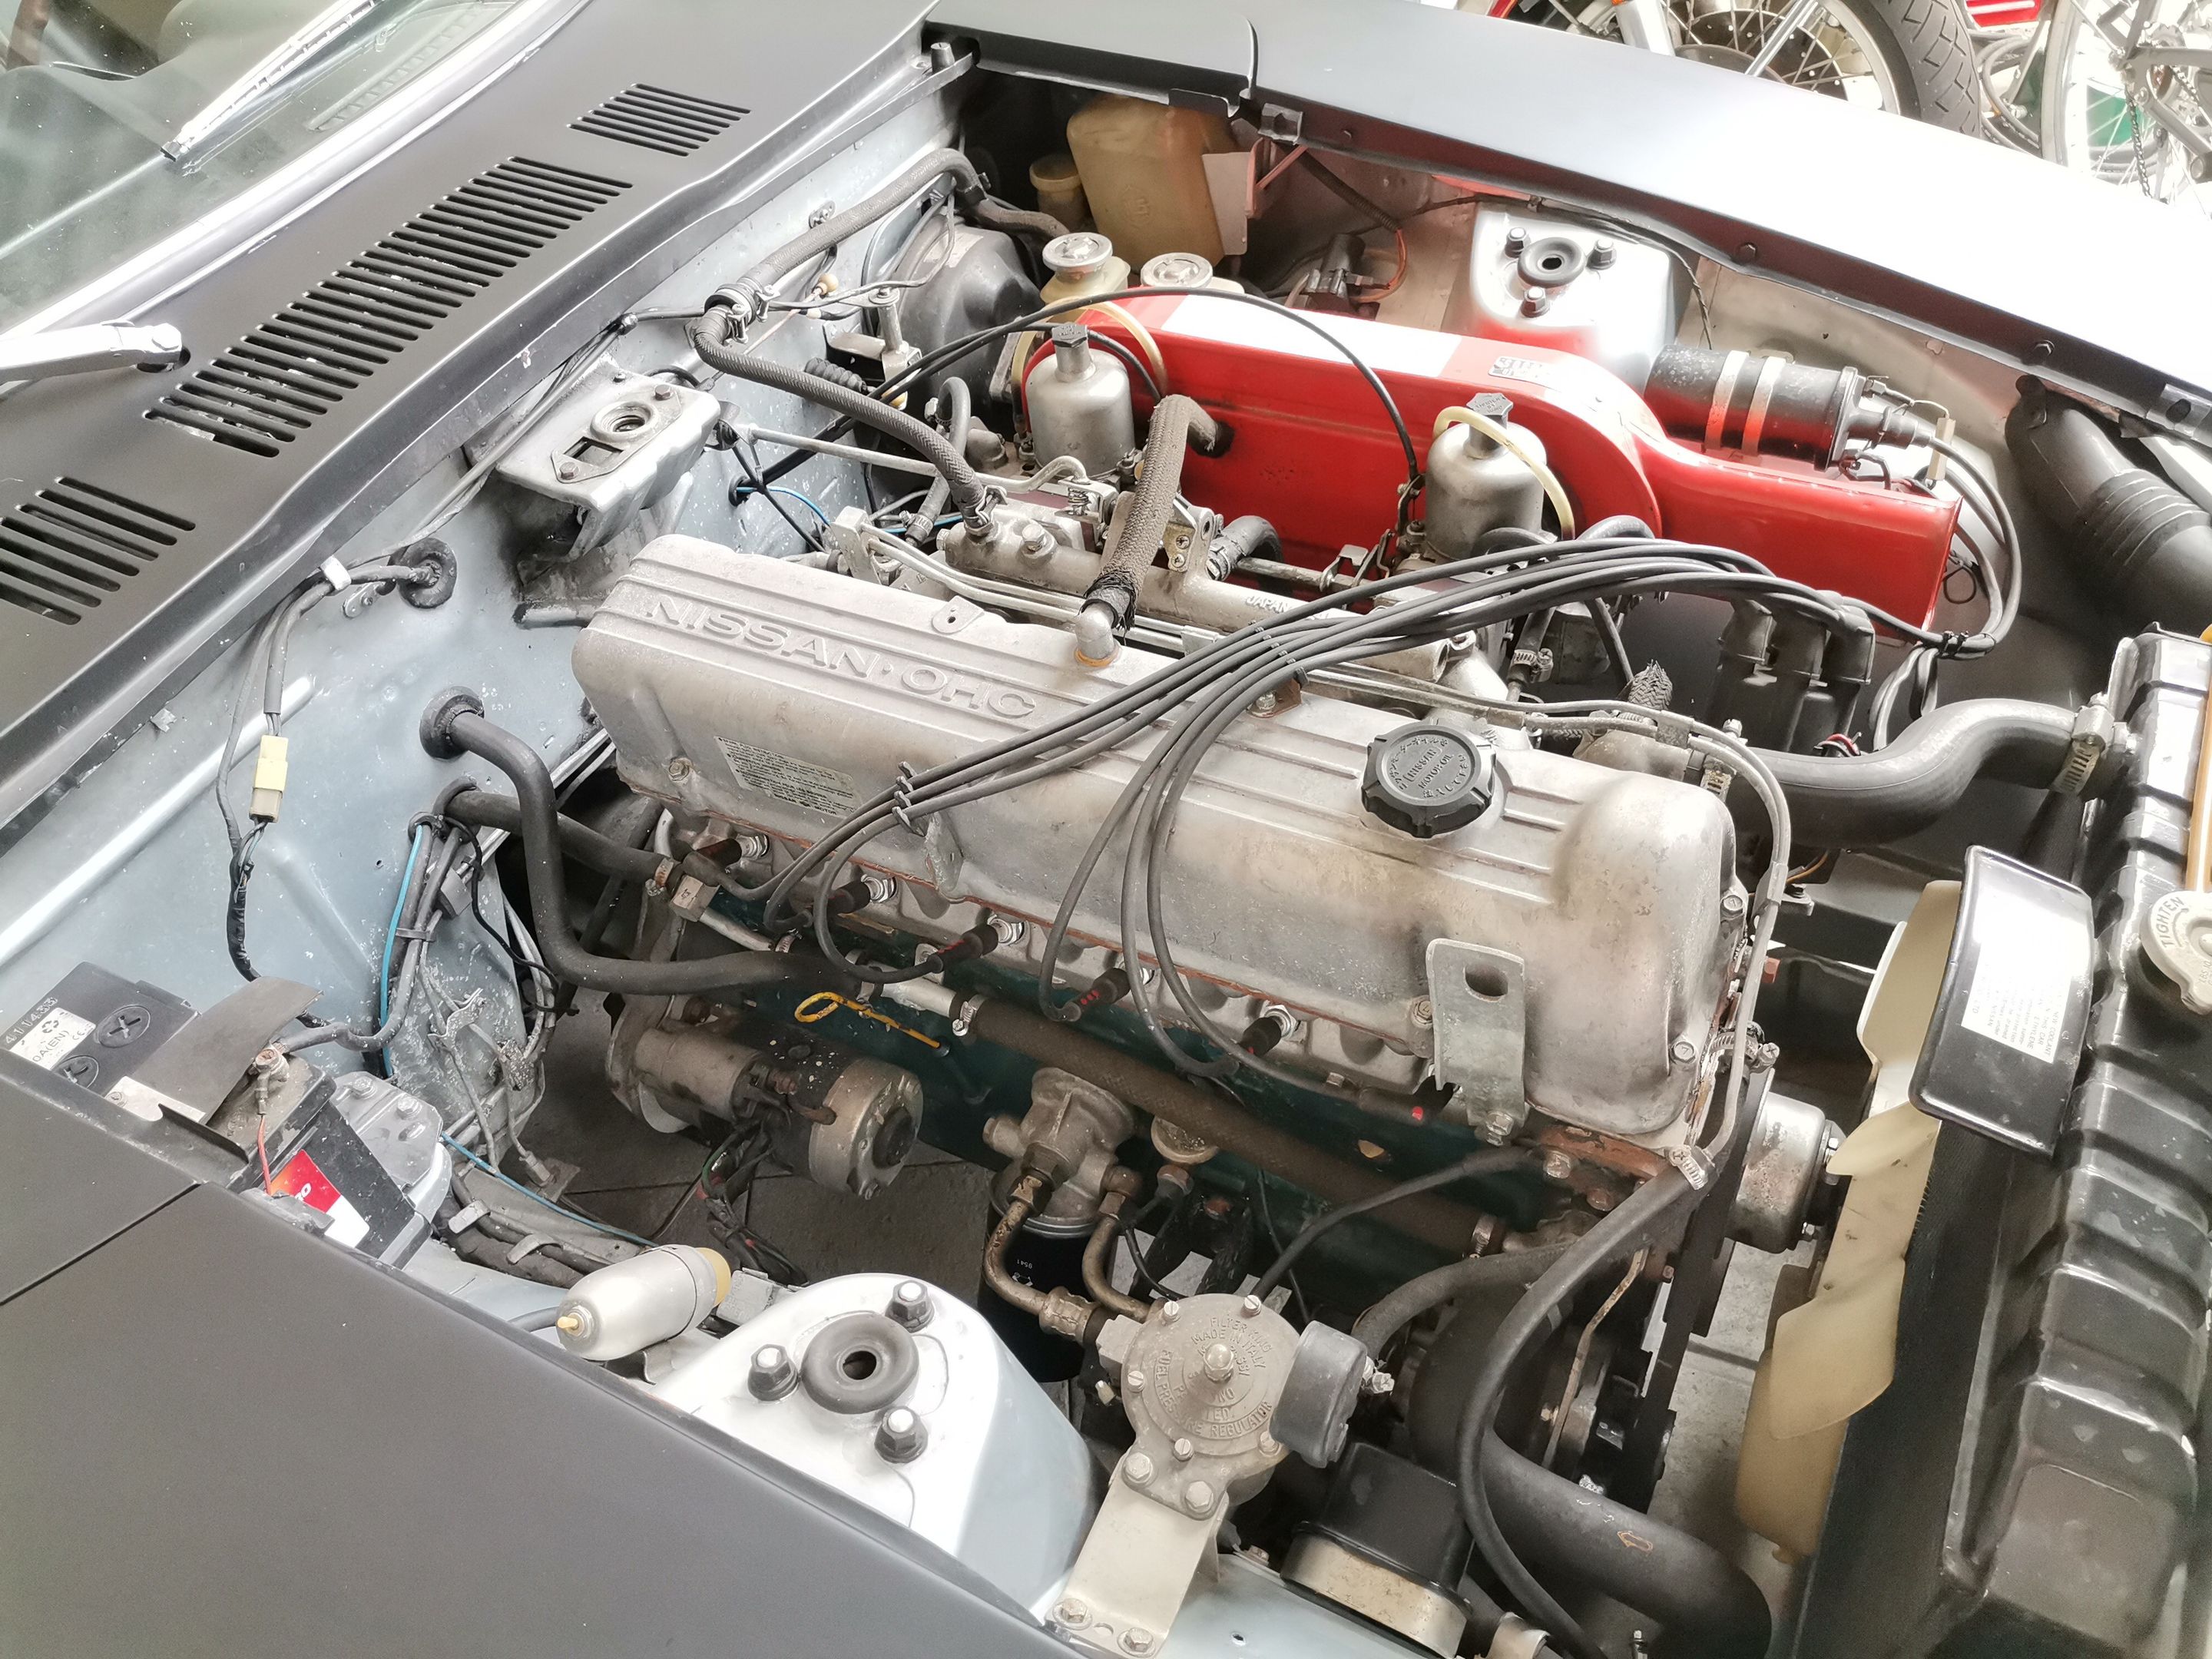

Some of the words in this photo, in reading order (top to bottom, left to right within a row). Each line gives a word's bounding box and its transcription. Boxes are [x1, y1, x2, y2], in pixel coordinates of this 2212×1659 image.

[1245, 595, 1291, 614] JAPAN
[646, 594, 880, 678] NISSAN
[899, 667, 1038, 720] OHC
[1407, 748, 1438, 779] NISSAN
[1418, 764, 1443, 790] MOTOR
[1440, 753, 1453, 766] OIL
[2156, 896, 2184, 949] TIGHTEN
[2038, 1031, 2046, 1045] CAR
[2045, 1025, 2057, 1056] COOLANT
[1210, 1316, 1247, 1333] FILTER
[1191, 1329, 1226, 1344] MADE
[1230, 1333, 1242, 1344] IN
[1242, 1340, 1266, 1368] ITALY
[1156, 1349, 1174, 1379] FUEL
[1210, 1402, 1273, 1438] REGULATOR
